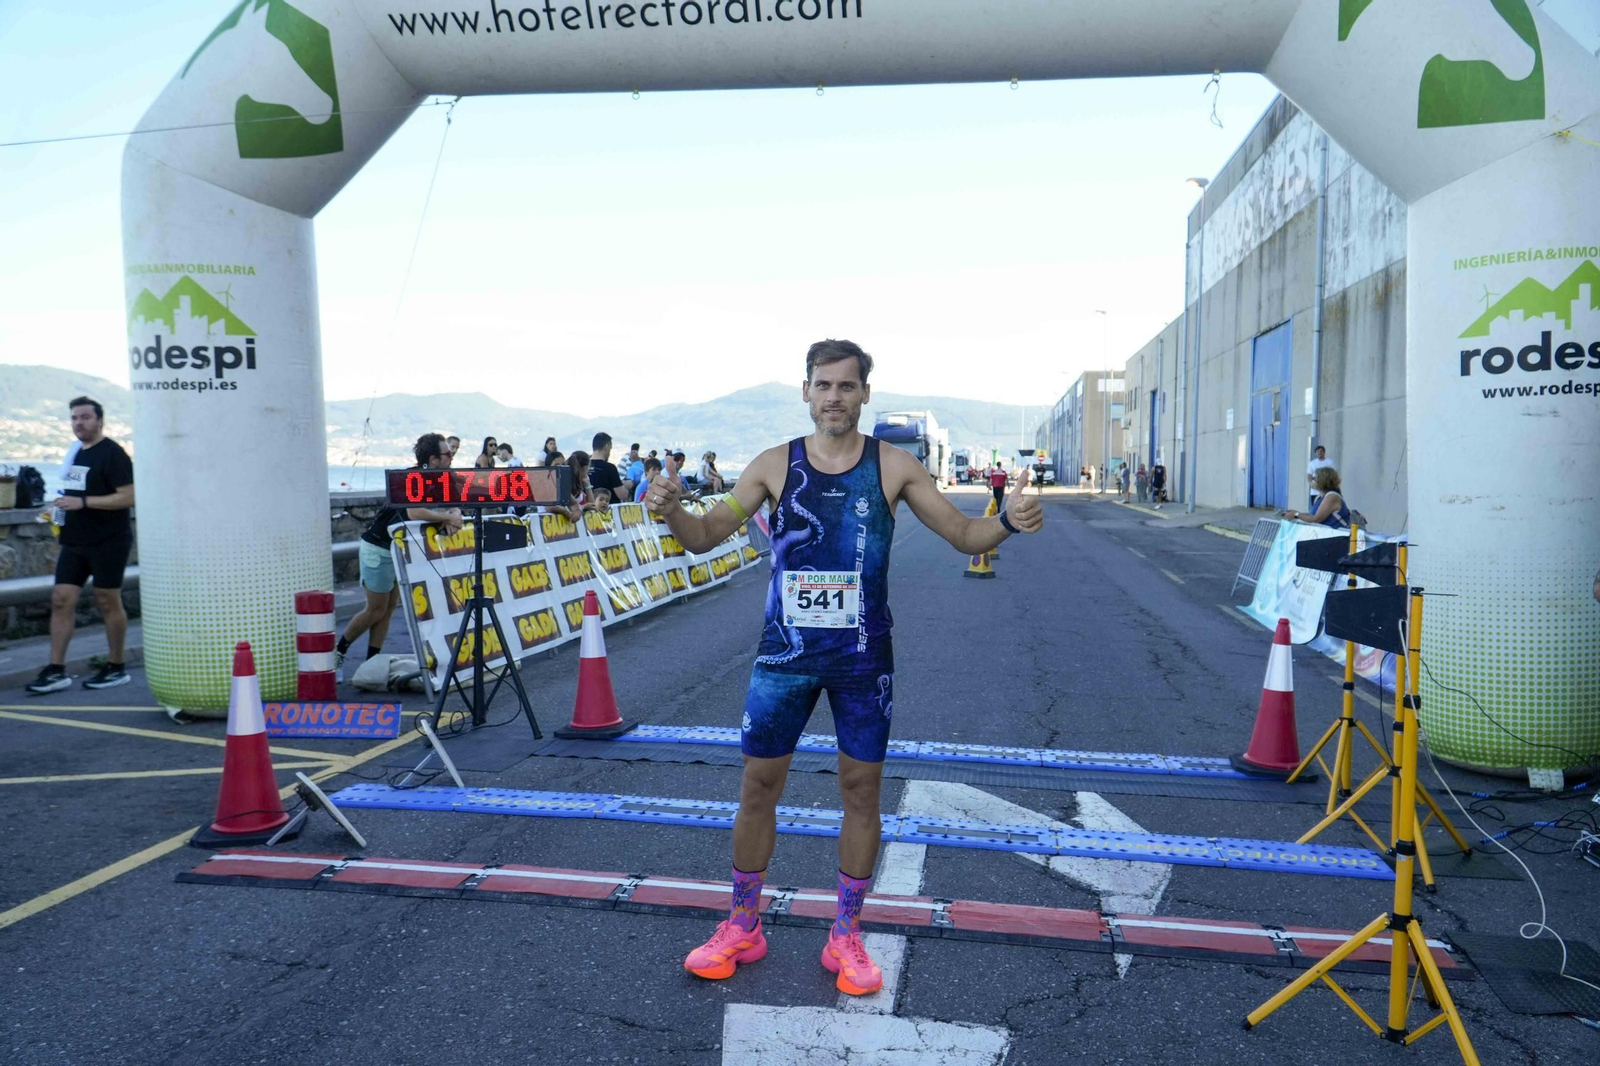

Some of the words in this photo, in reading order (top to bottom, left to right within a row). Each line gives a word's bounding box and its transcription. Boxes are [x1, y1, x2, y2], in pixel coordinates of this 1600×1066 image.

[388, 0, 863, 36] www.hotelrectoral.com
[1454, 247, 1600, 270] INGENIERÍA&INMO
[130, 334, 257, 379] odespi
[808, 574, 826, 583] POR
[797, 589, 844, 610] 541
[264, 702, 396, 725] RONOTEC
[1227, 849, 1378, 868] CRONOTEC
